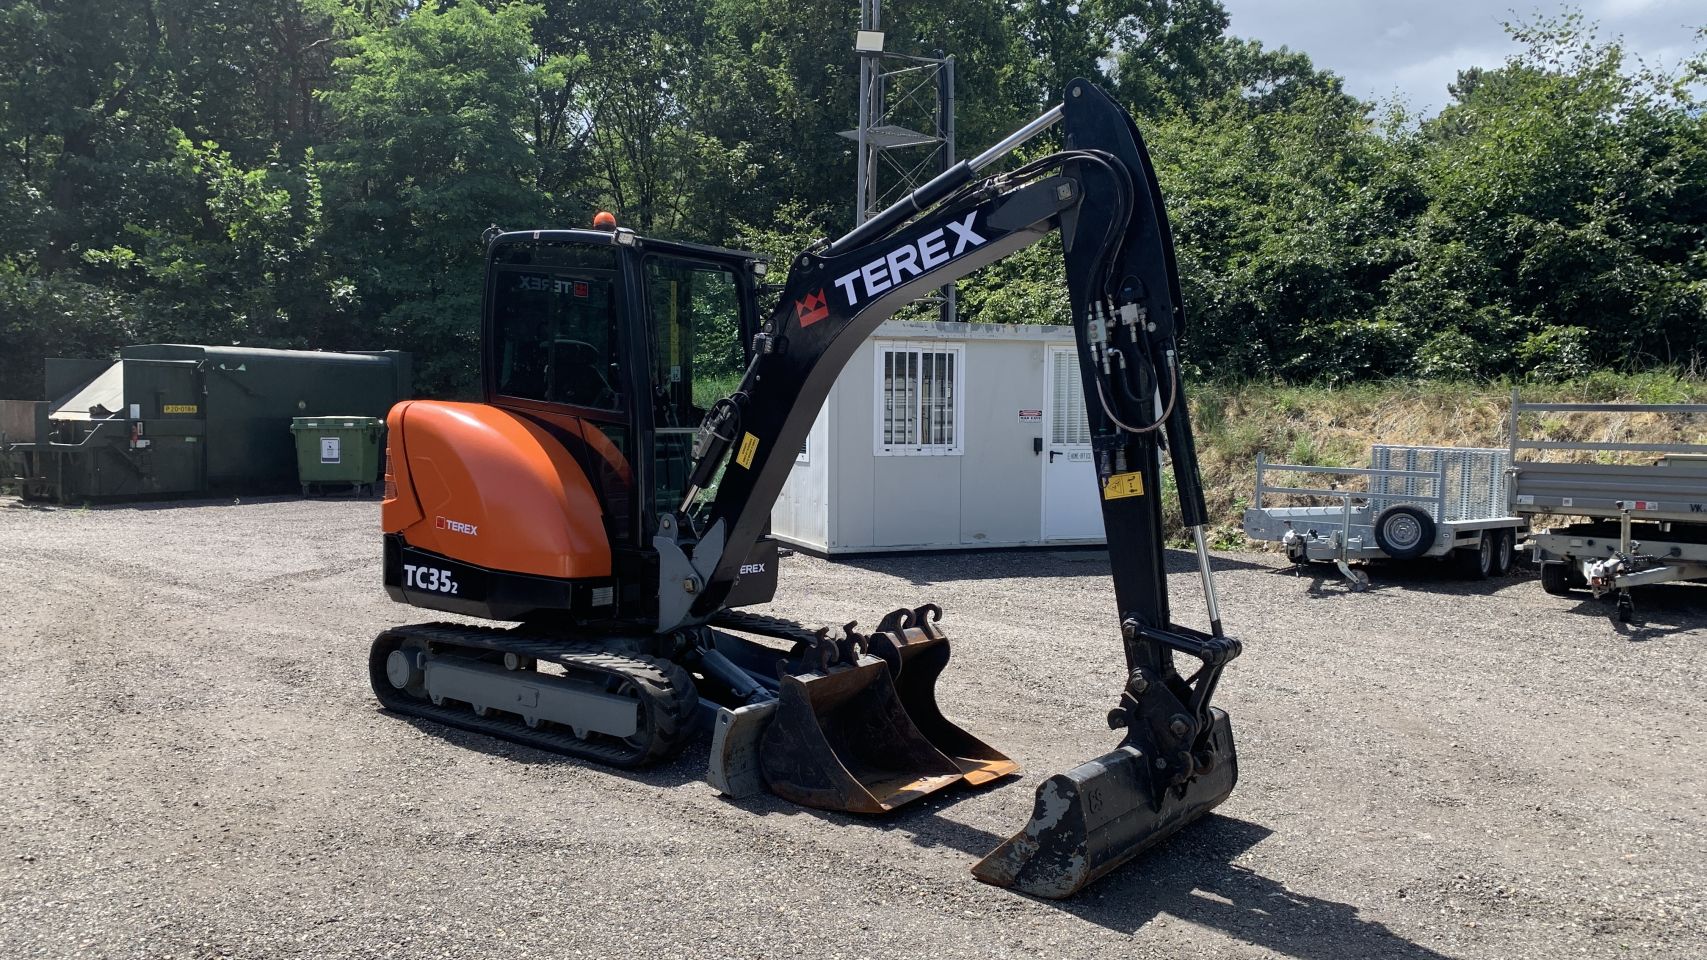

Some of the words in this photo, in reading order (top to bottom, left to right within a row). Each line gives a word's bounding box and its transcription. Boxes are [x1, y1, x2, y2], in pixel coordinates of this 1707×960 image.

[834, 210, 987, 306] TEREX
[446, 519, 478, 536] TEREX
[740, 563, 765, 574] EREX
